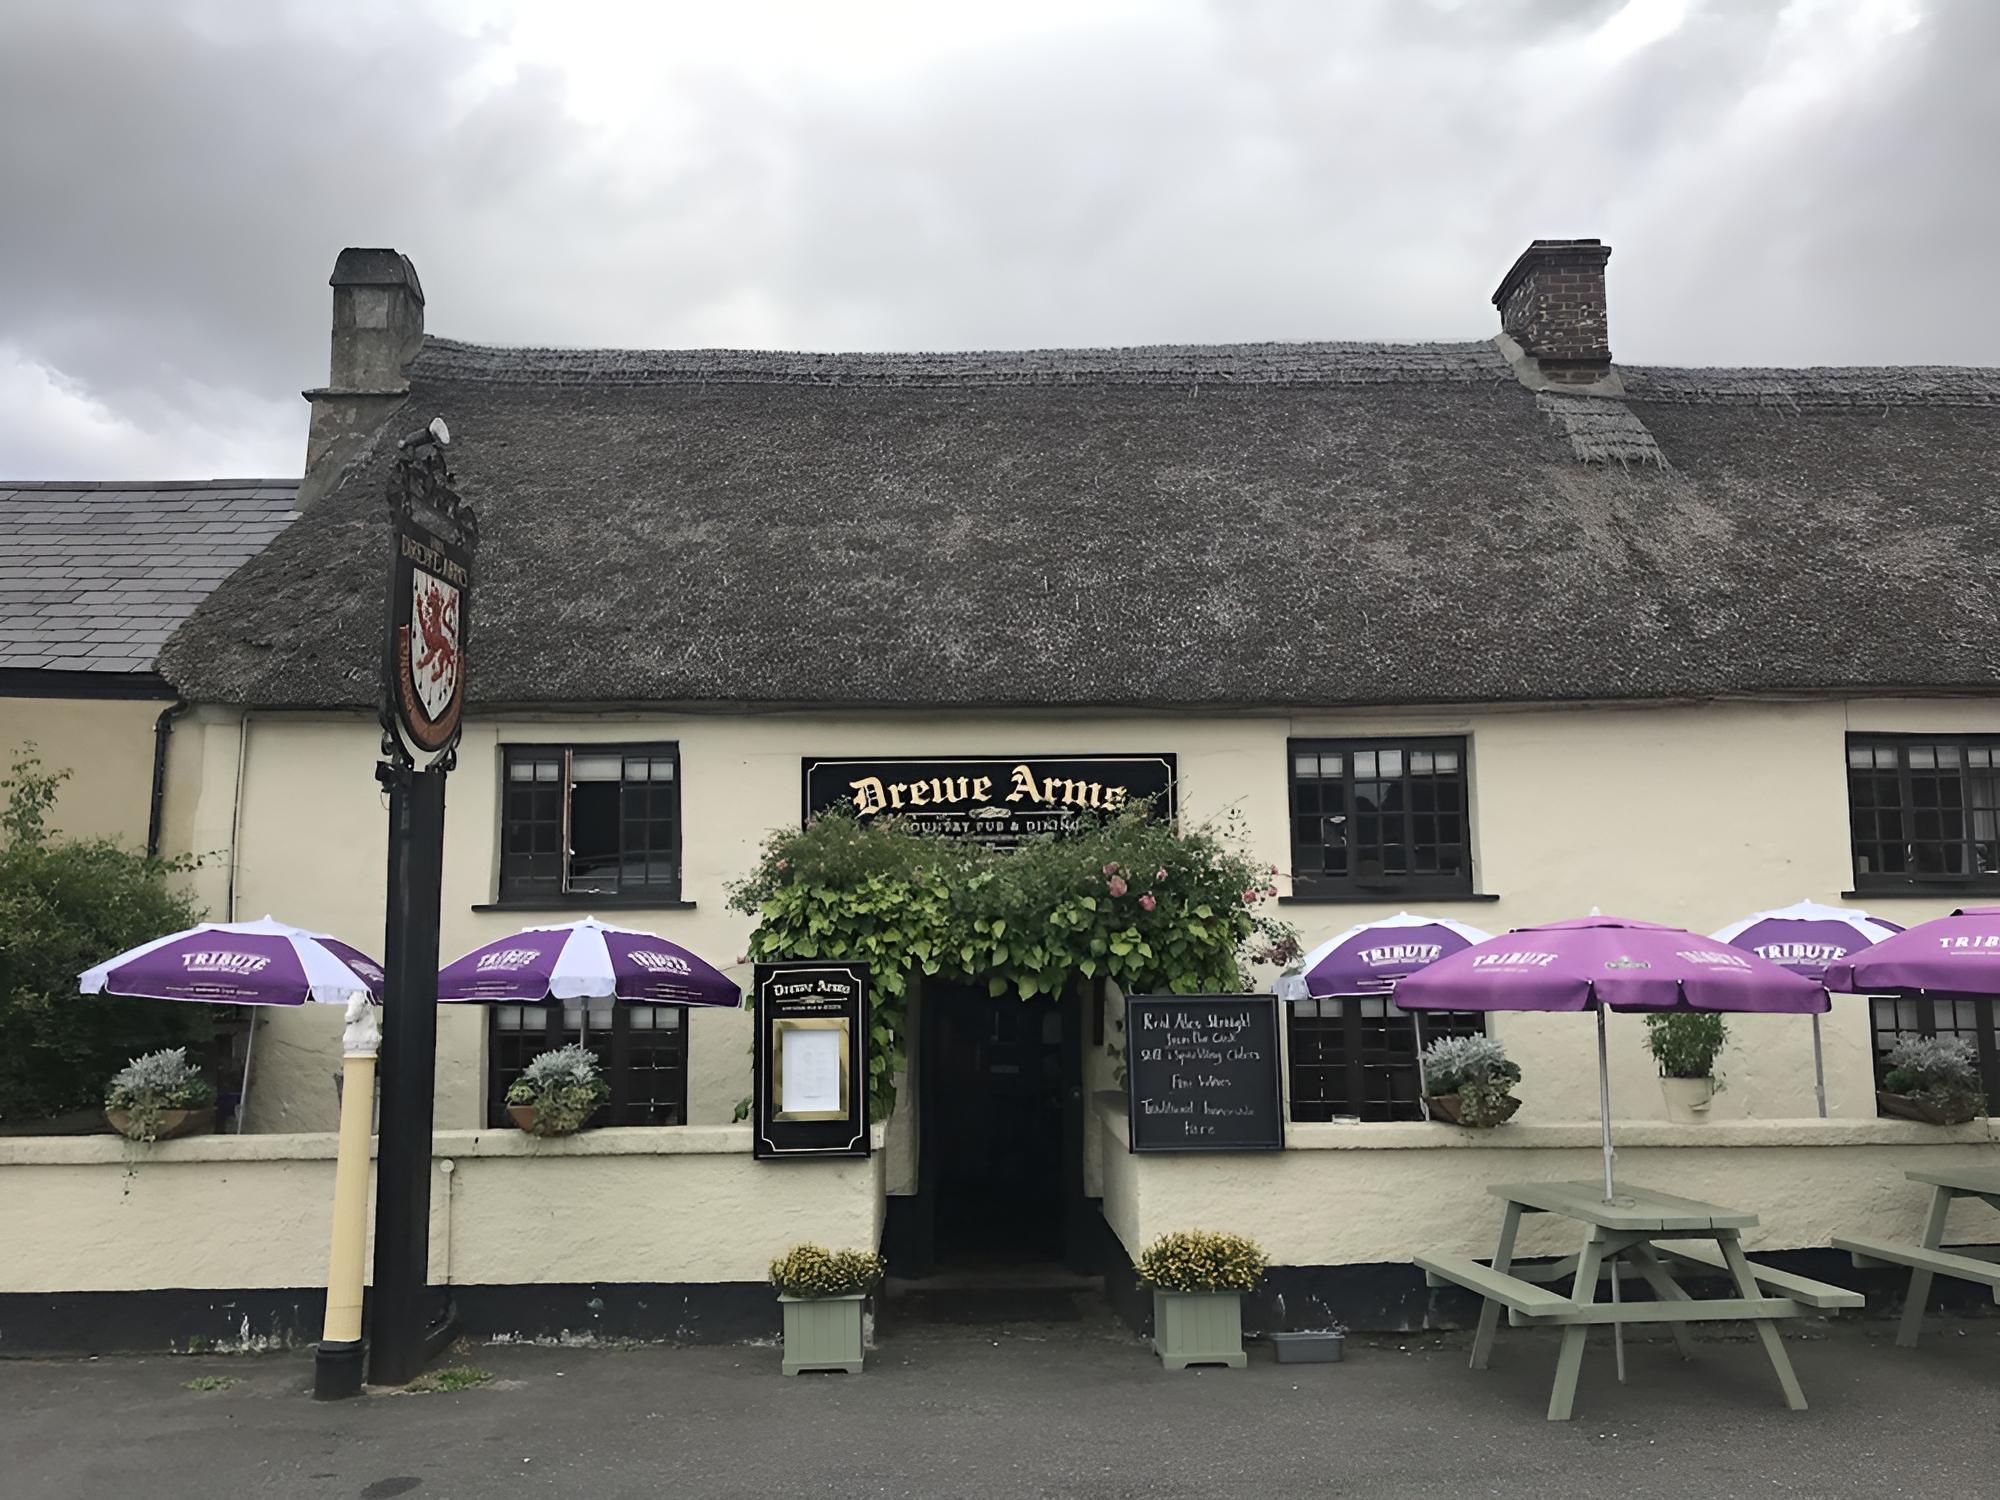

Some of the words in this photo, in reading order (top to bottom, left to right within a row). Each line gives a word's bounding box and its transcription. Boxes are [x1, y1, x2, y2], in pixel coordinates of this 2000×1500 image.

[849, 776, 992, 819] Drewe
[1005, 764, 1128, 811] Arms
[182, 951, 271, 971] TRIBUTE
[1357, 943, 1442, 963] TRIBUTE
[1472, 951, 1558, 968] TRIBUTE
[1753, 943, 1847, 960] TRIBUTE
